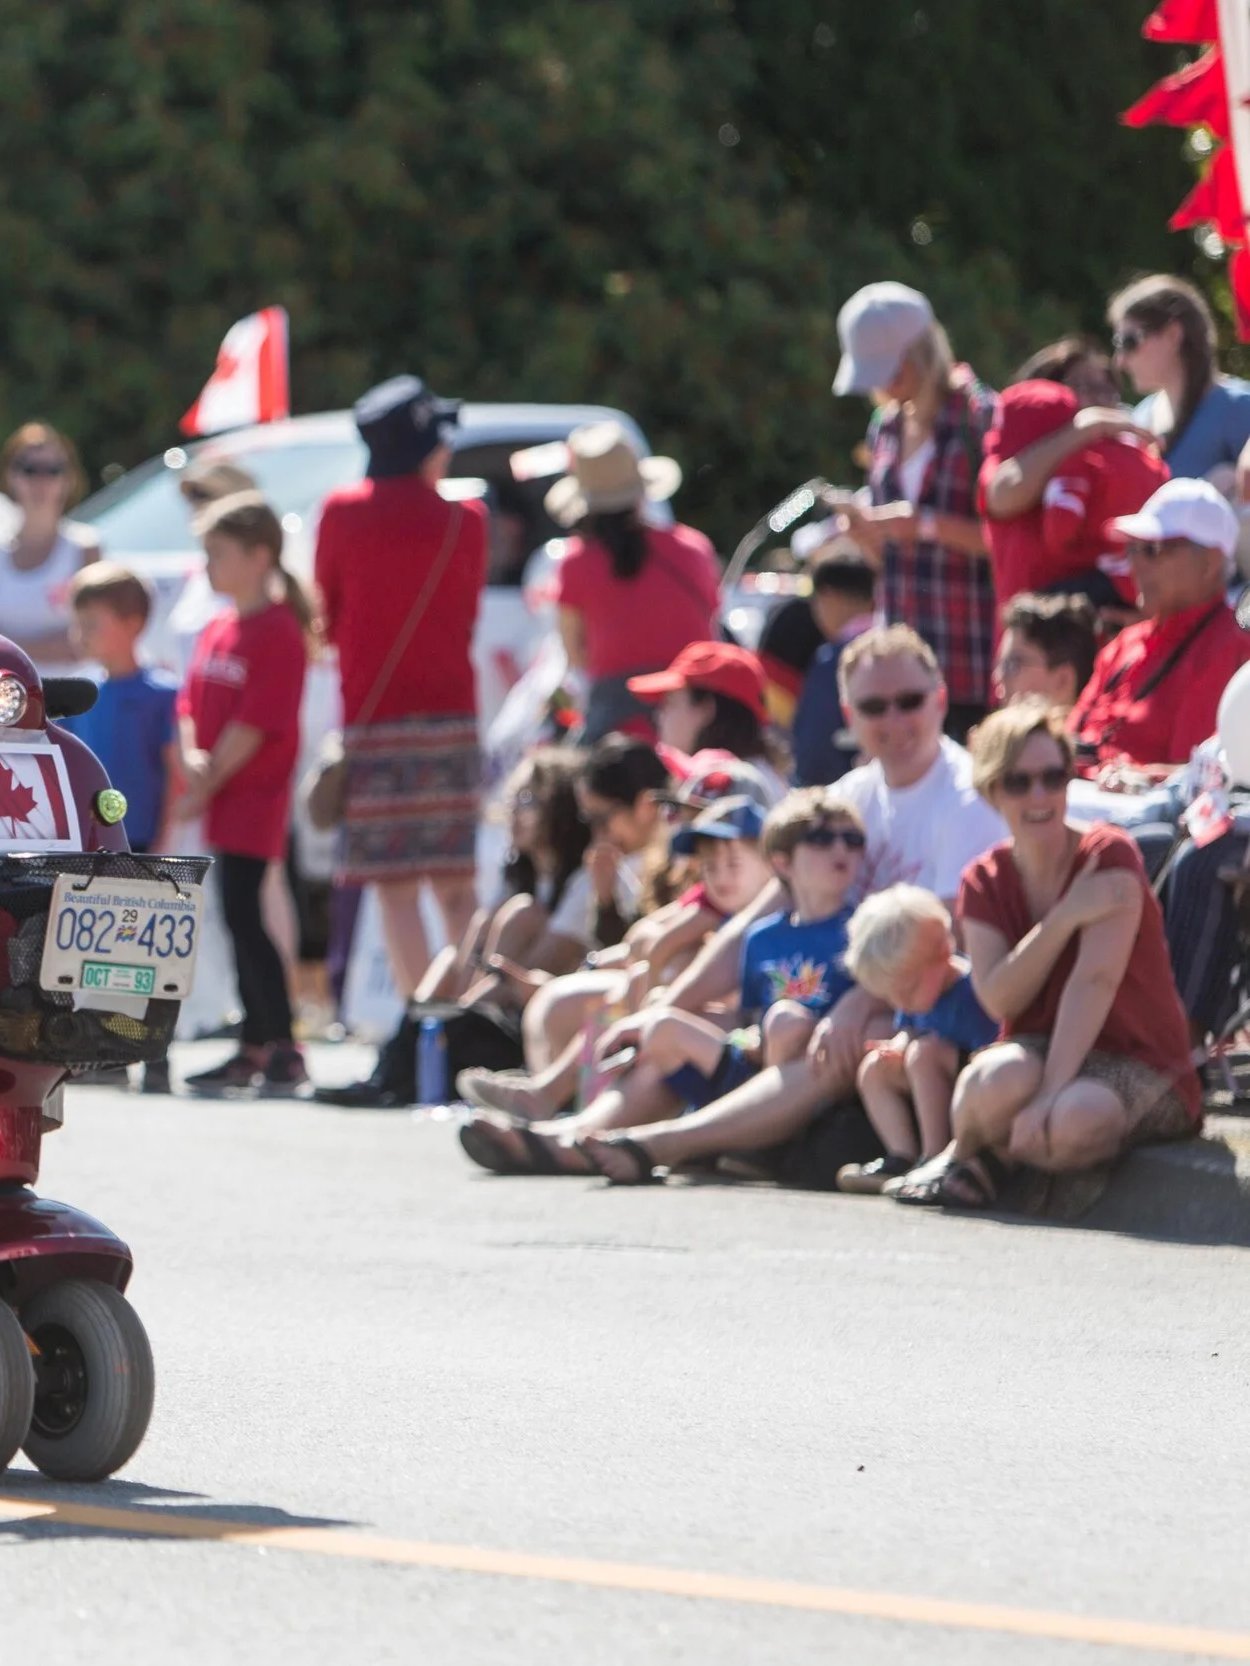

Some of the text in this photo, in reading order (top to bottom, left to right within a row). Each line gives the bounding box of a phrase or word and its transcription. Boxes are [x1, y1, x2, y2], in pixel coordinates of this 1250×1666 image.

[64, 891, 197, 912] Beautiful British Columbia
[121, 909, 138, 923] 29
[56, 908, 196, 958] 082 433
[85, 967, 111, 986] OCT
[134, 972, 151, 990] 93
